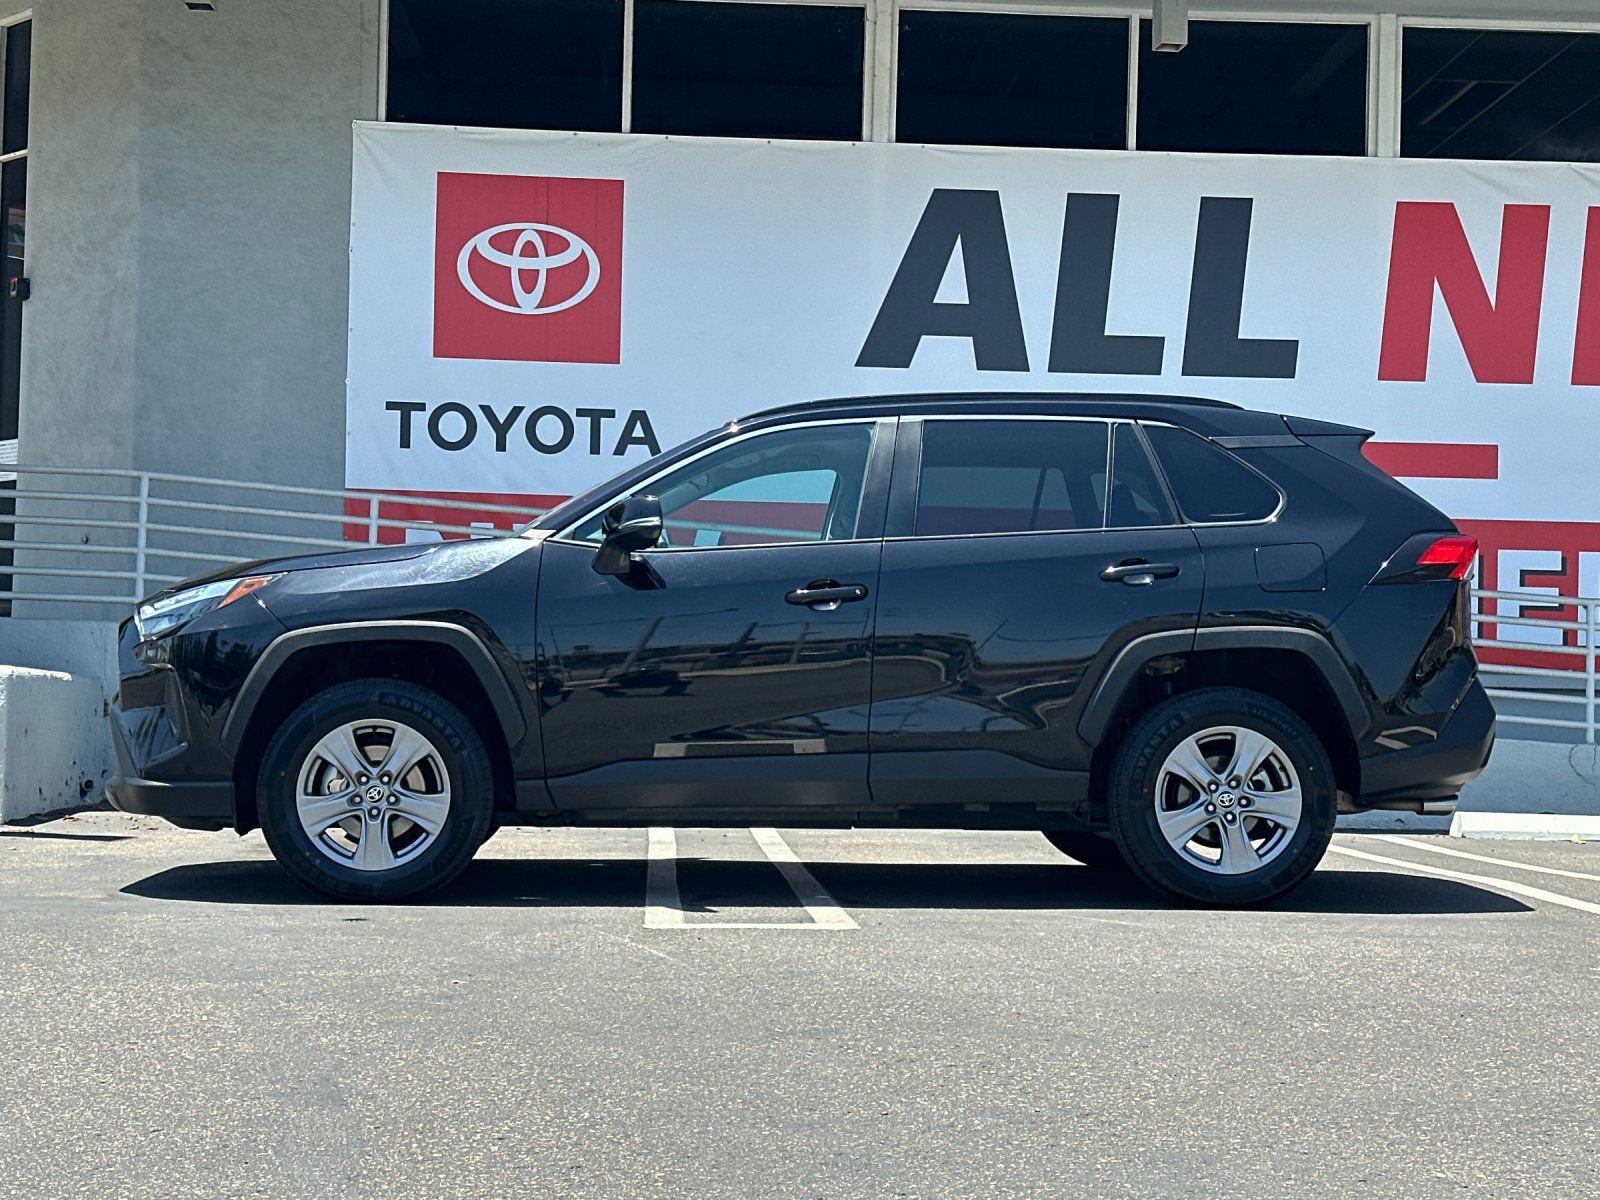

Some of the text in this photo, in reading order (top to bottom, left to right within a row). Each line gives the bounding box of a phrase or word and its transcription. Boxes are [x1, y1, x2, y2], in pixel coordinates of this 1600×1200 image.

[854, 188, 1299, 379] ALL
[385, 401, 662, 456] TOYOTA
[383, 693, 462, 752] ADVANTA
